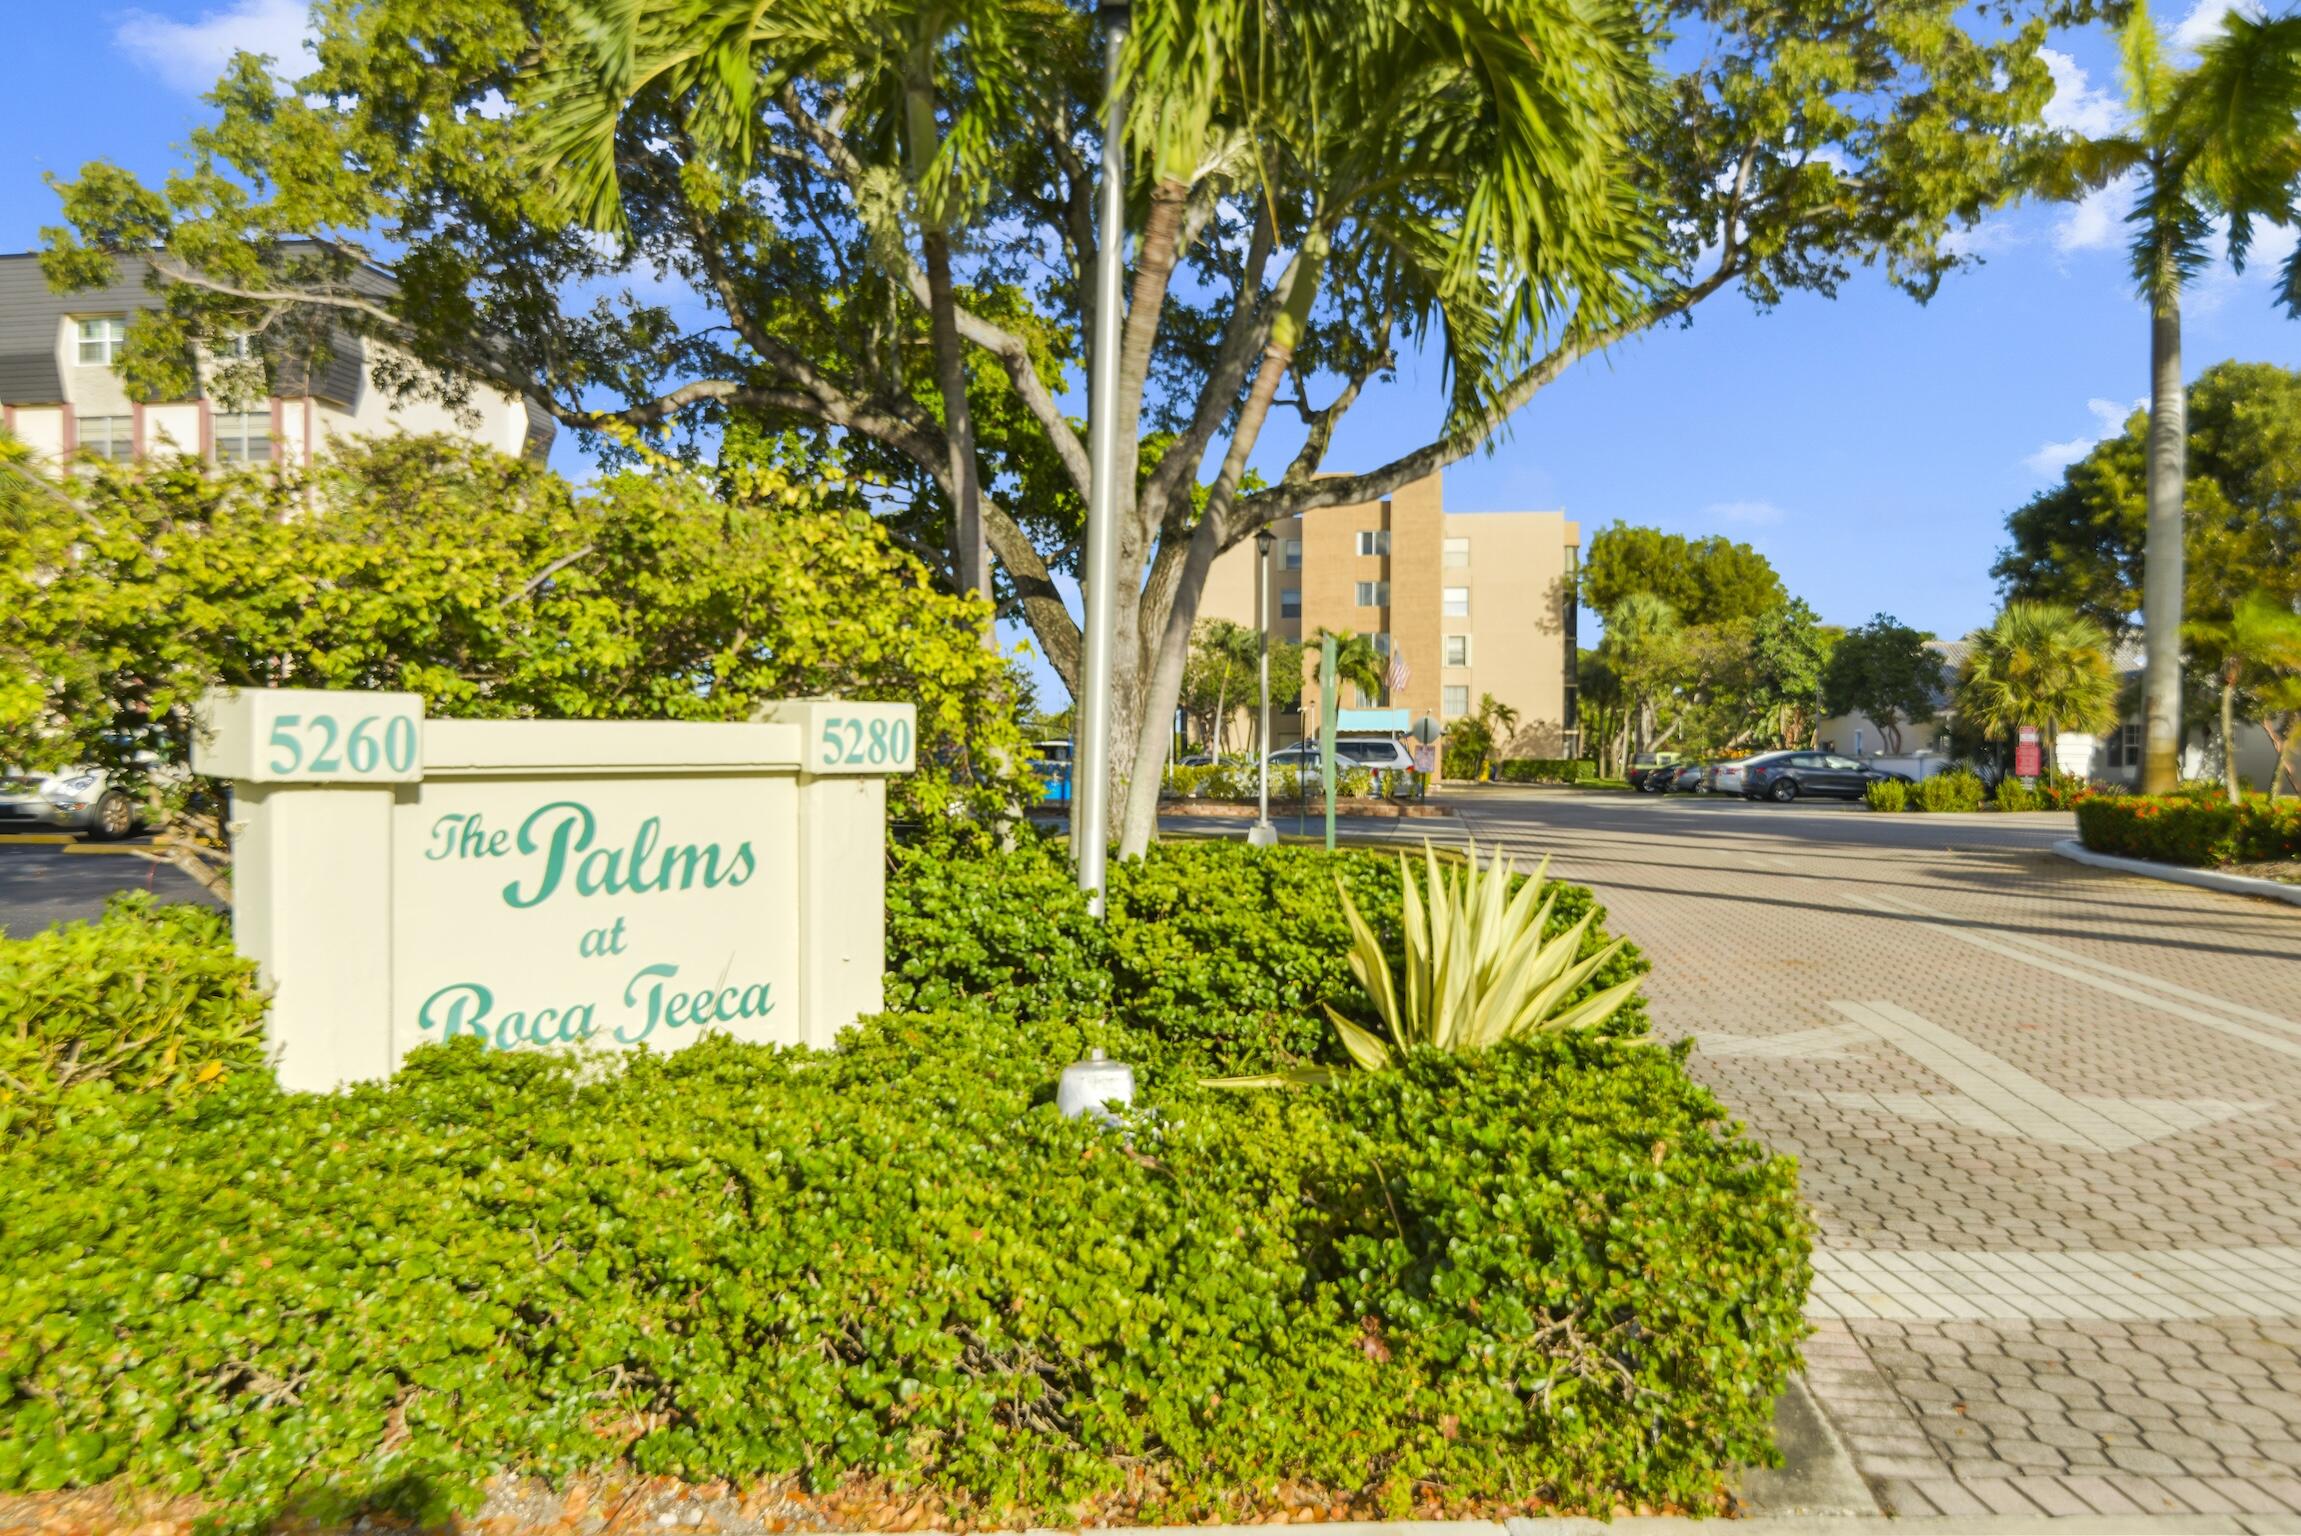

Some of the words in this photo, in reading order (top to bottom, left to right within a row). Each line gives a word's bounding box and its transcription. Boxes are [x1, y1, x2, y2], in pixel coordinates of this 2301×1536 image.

[268, 714, 418, 775] 5260
[821, 717, 911, 766] 5280
[424, 812, 511, 862] The
[502, 800, 757, 909] Palms
[579, 916, 628, 959] at
[418, 982, 601, 1054] Boca
[613, 963, 776, 1045] Teeca
